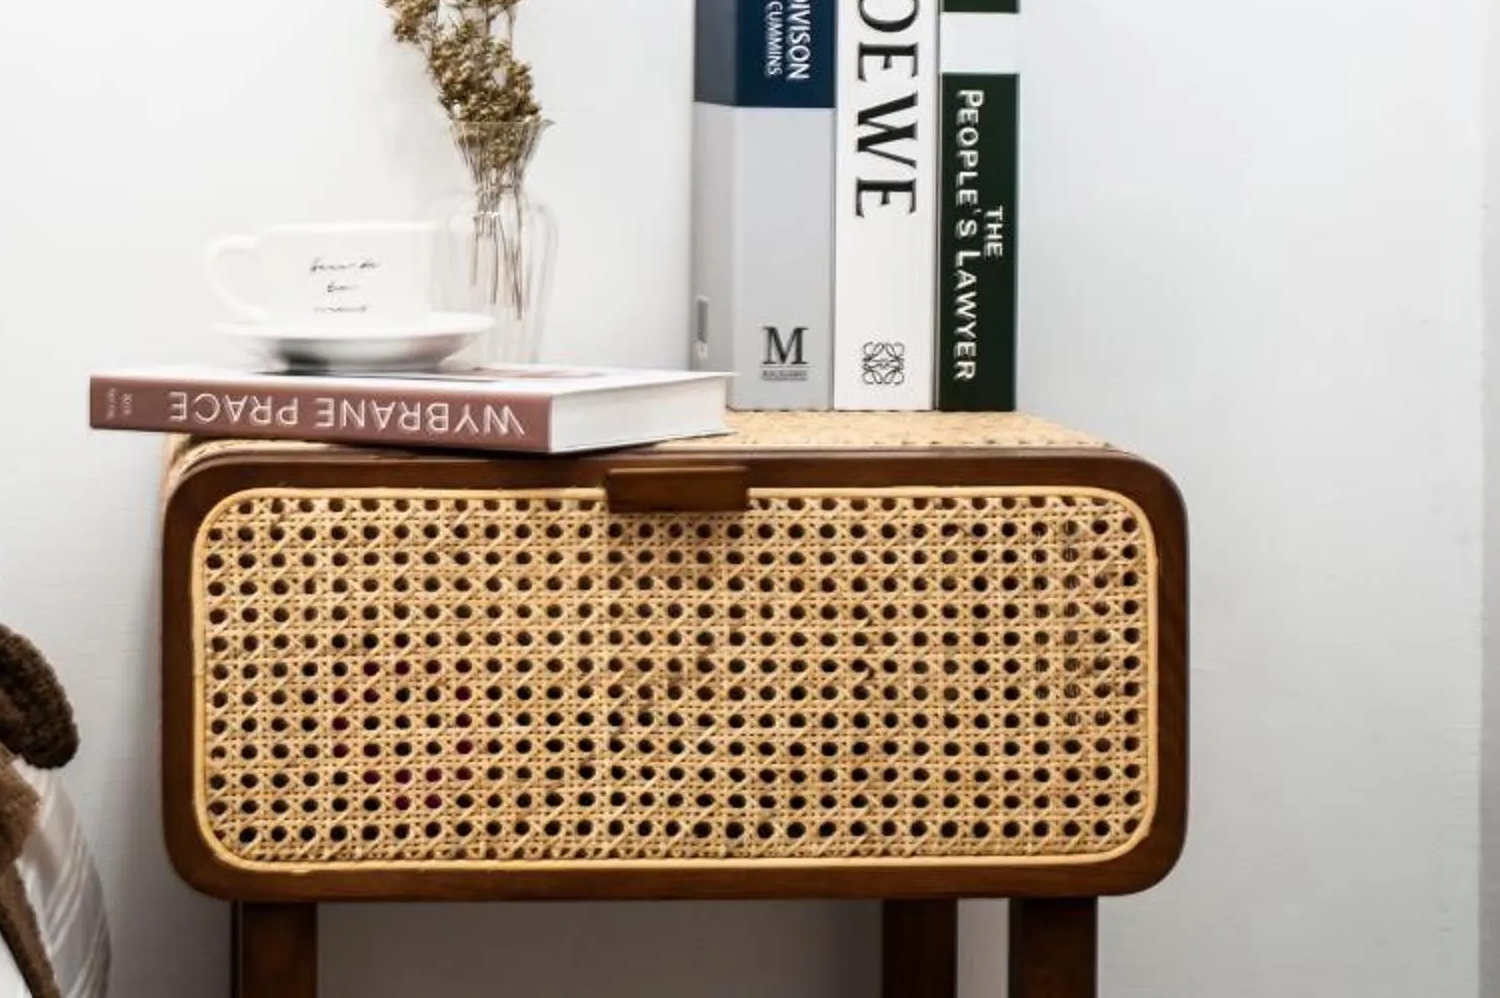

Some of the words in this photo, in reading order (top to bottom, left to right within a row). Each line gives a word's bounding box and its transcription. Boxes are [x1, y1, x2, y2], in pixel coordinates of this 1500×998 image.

[765, 0, 783, 76] CUMMINS
[956, 89, 985, 237] PEOPLE'S
[984, 205, 1004, 259] THE
[953, 250, 982, 382] LAWYER
[762, 326, 809, 364] M
[167, 390, 299, 427] PRACE
[313, 396, 525, 437] WYBRANE
